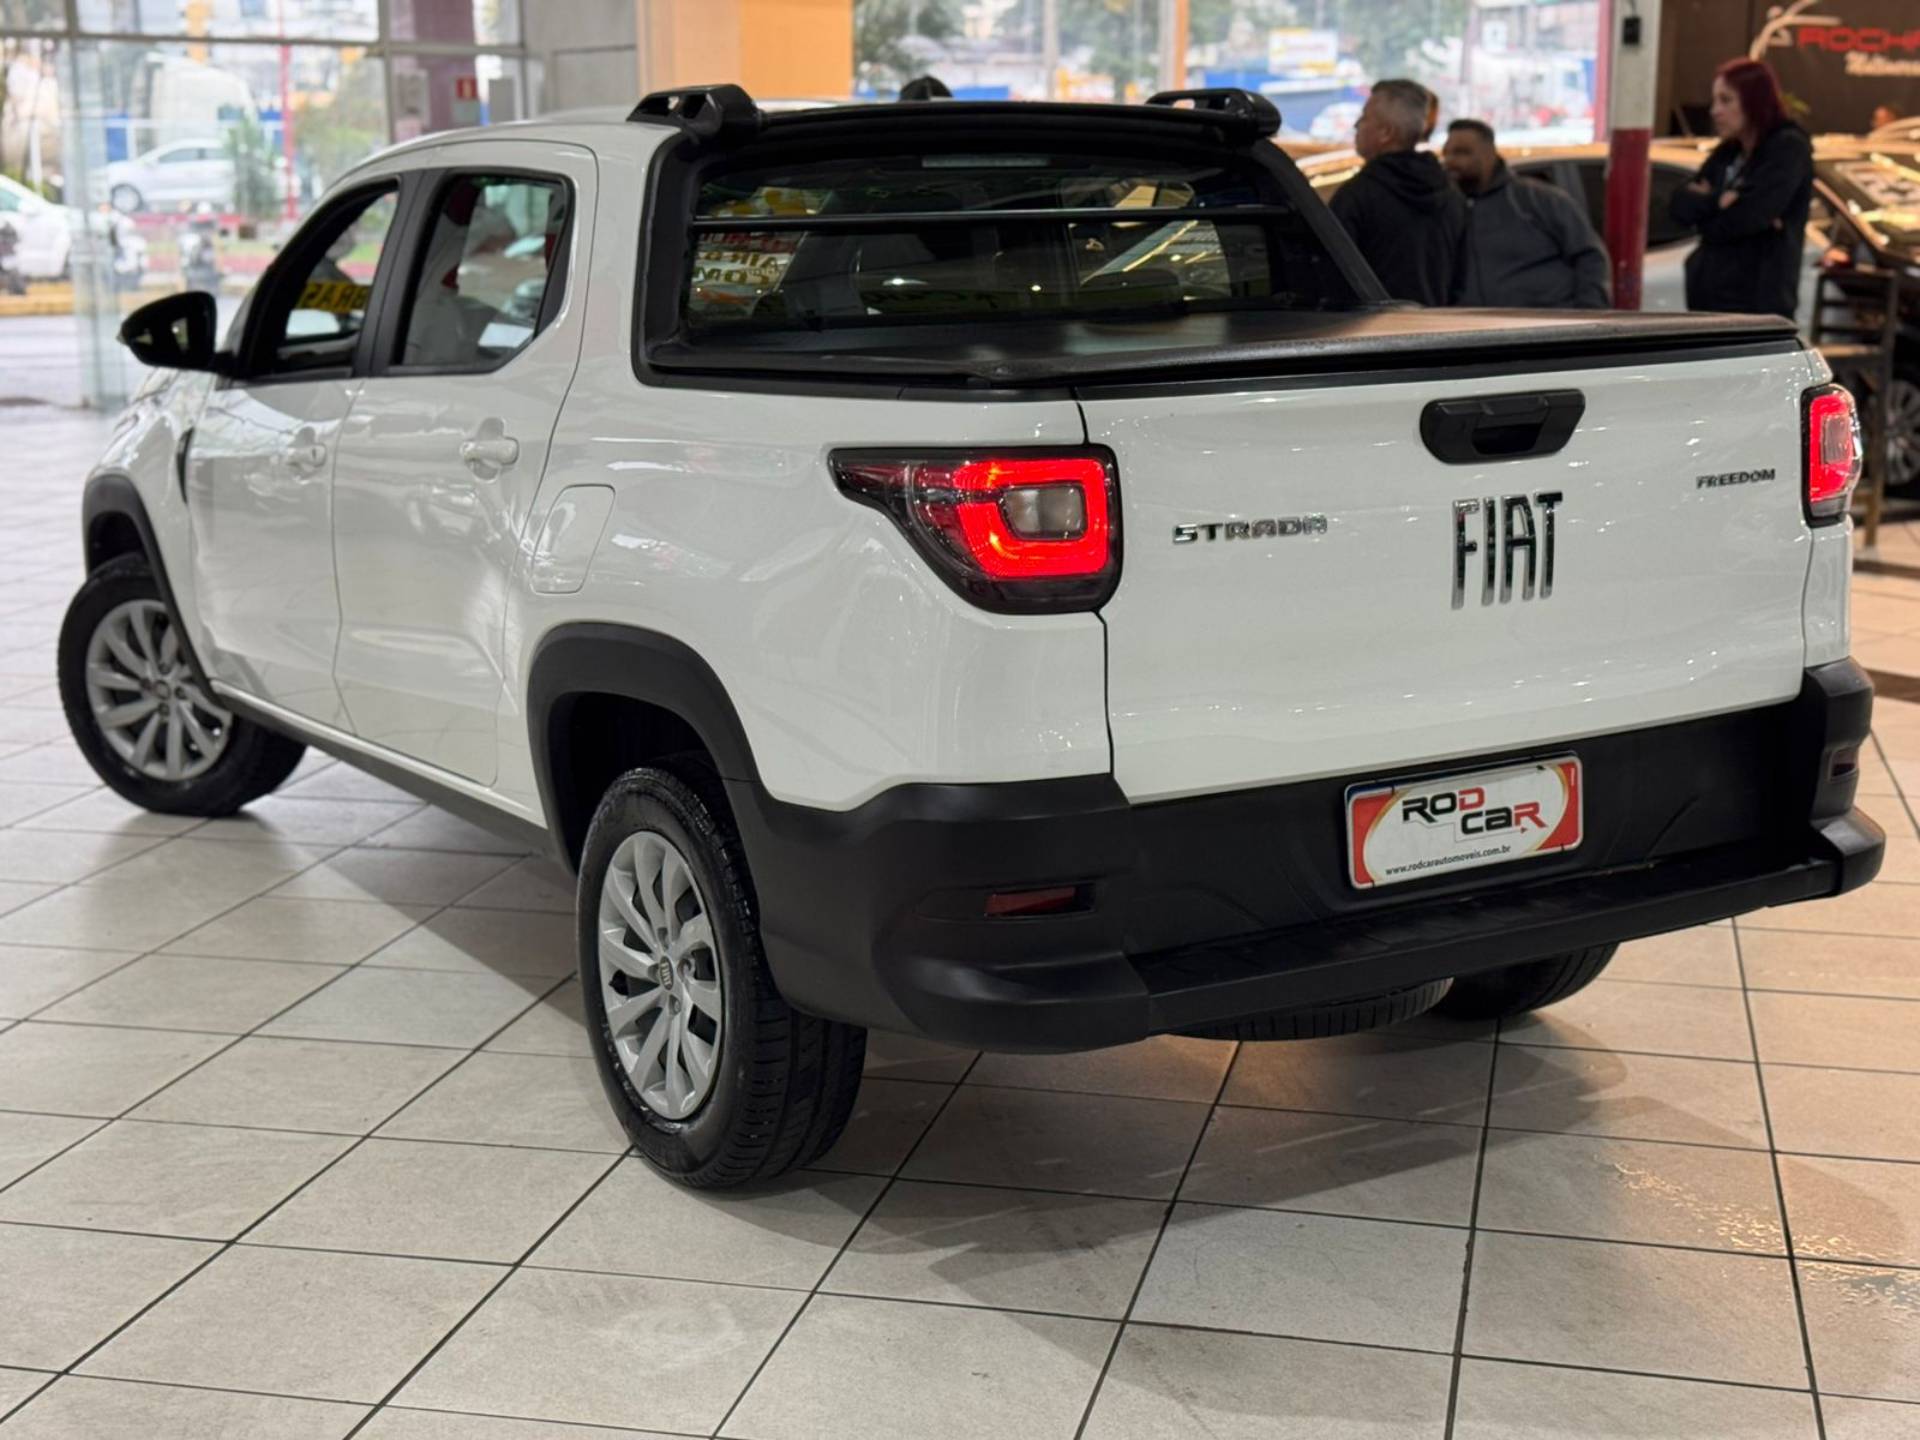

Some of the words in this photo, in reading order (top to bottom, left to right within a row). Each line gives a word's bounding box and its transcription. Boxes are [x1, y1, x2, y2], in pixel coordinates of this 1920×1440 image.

[1696, 467, 1776, 489] FREEDOM
[1173, 515, 1328, 545] STRADA
[1451, 491, 1563, 610] FIAT
[1401, 787, 1485, 824] ROD
[1385, 844, 1512, 876] www.rodcarautomoveis.com.br
